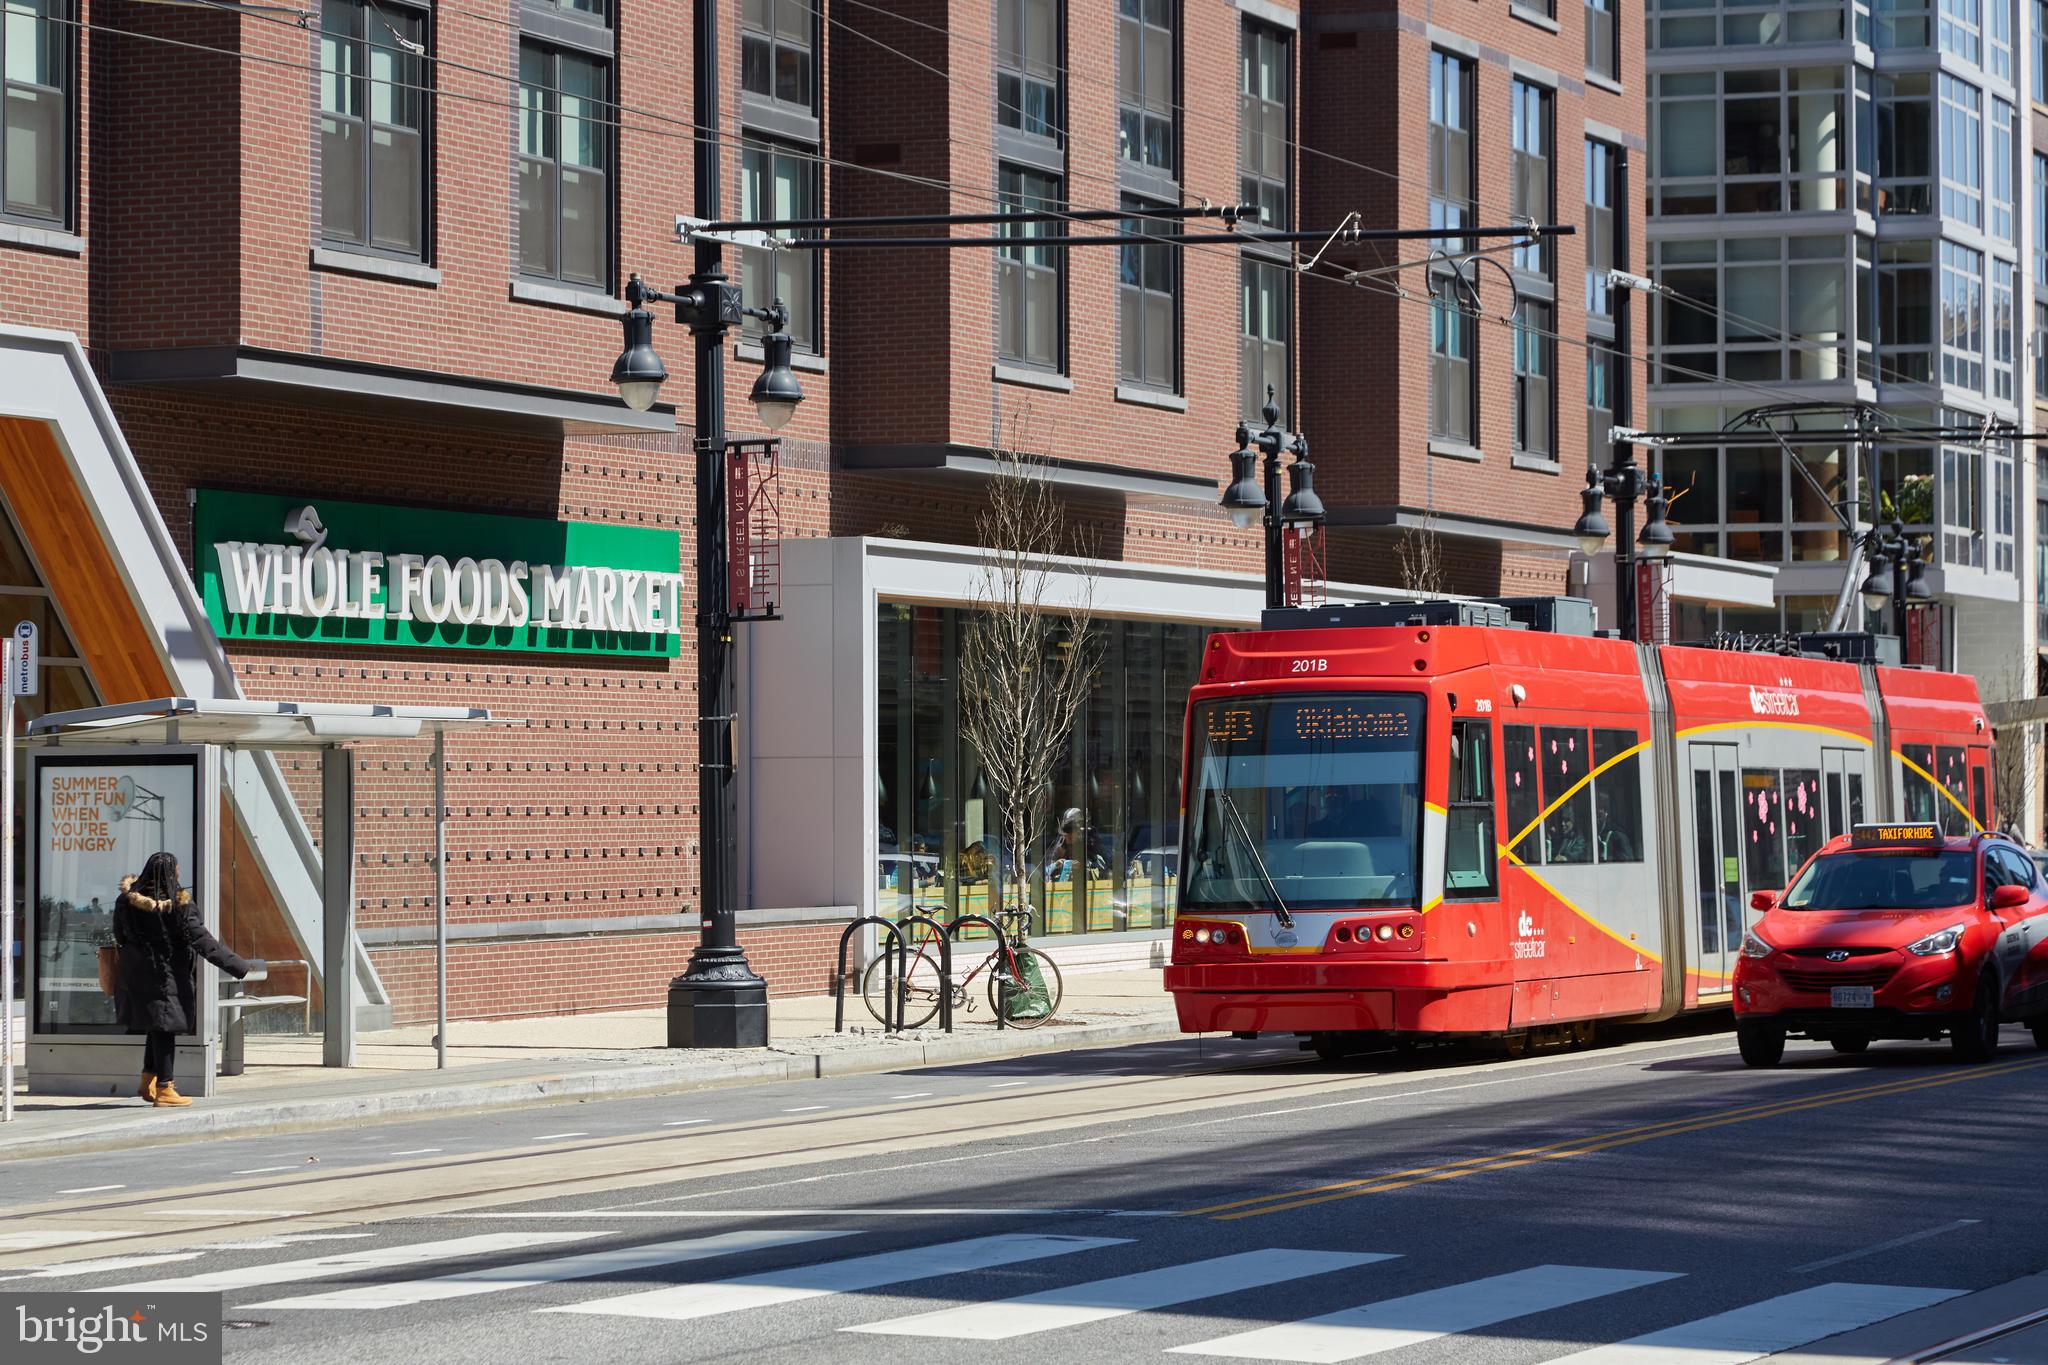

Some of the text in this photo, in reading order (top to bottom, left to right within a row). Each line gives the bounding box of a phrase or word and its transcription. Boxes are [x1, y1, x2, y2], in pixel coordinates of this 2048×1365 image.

[213, 540, 685, 634] WHOLE FOODS MARKET
[20, 640, 30, 693] metrobus
[1291, 658, 1328, 673] 201B
[52, 776, 118, 791] SUMMER
[52, 791, 126, 806] ISN'T FUN
[52, 807, 100, 821] WHEN
[51, 821, 108, 836] YOU'RE
[51, 837, 116, 851] HUNGRY
